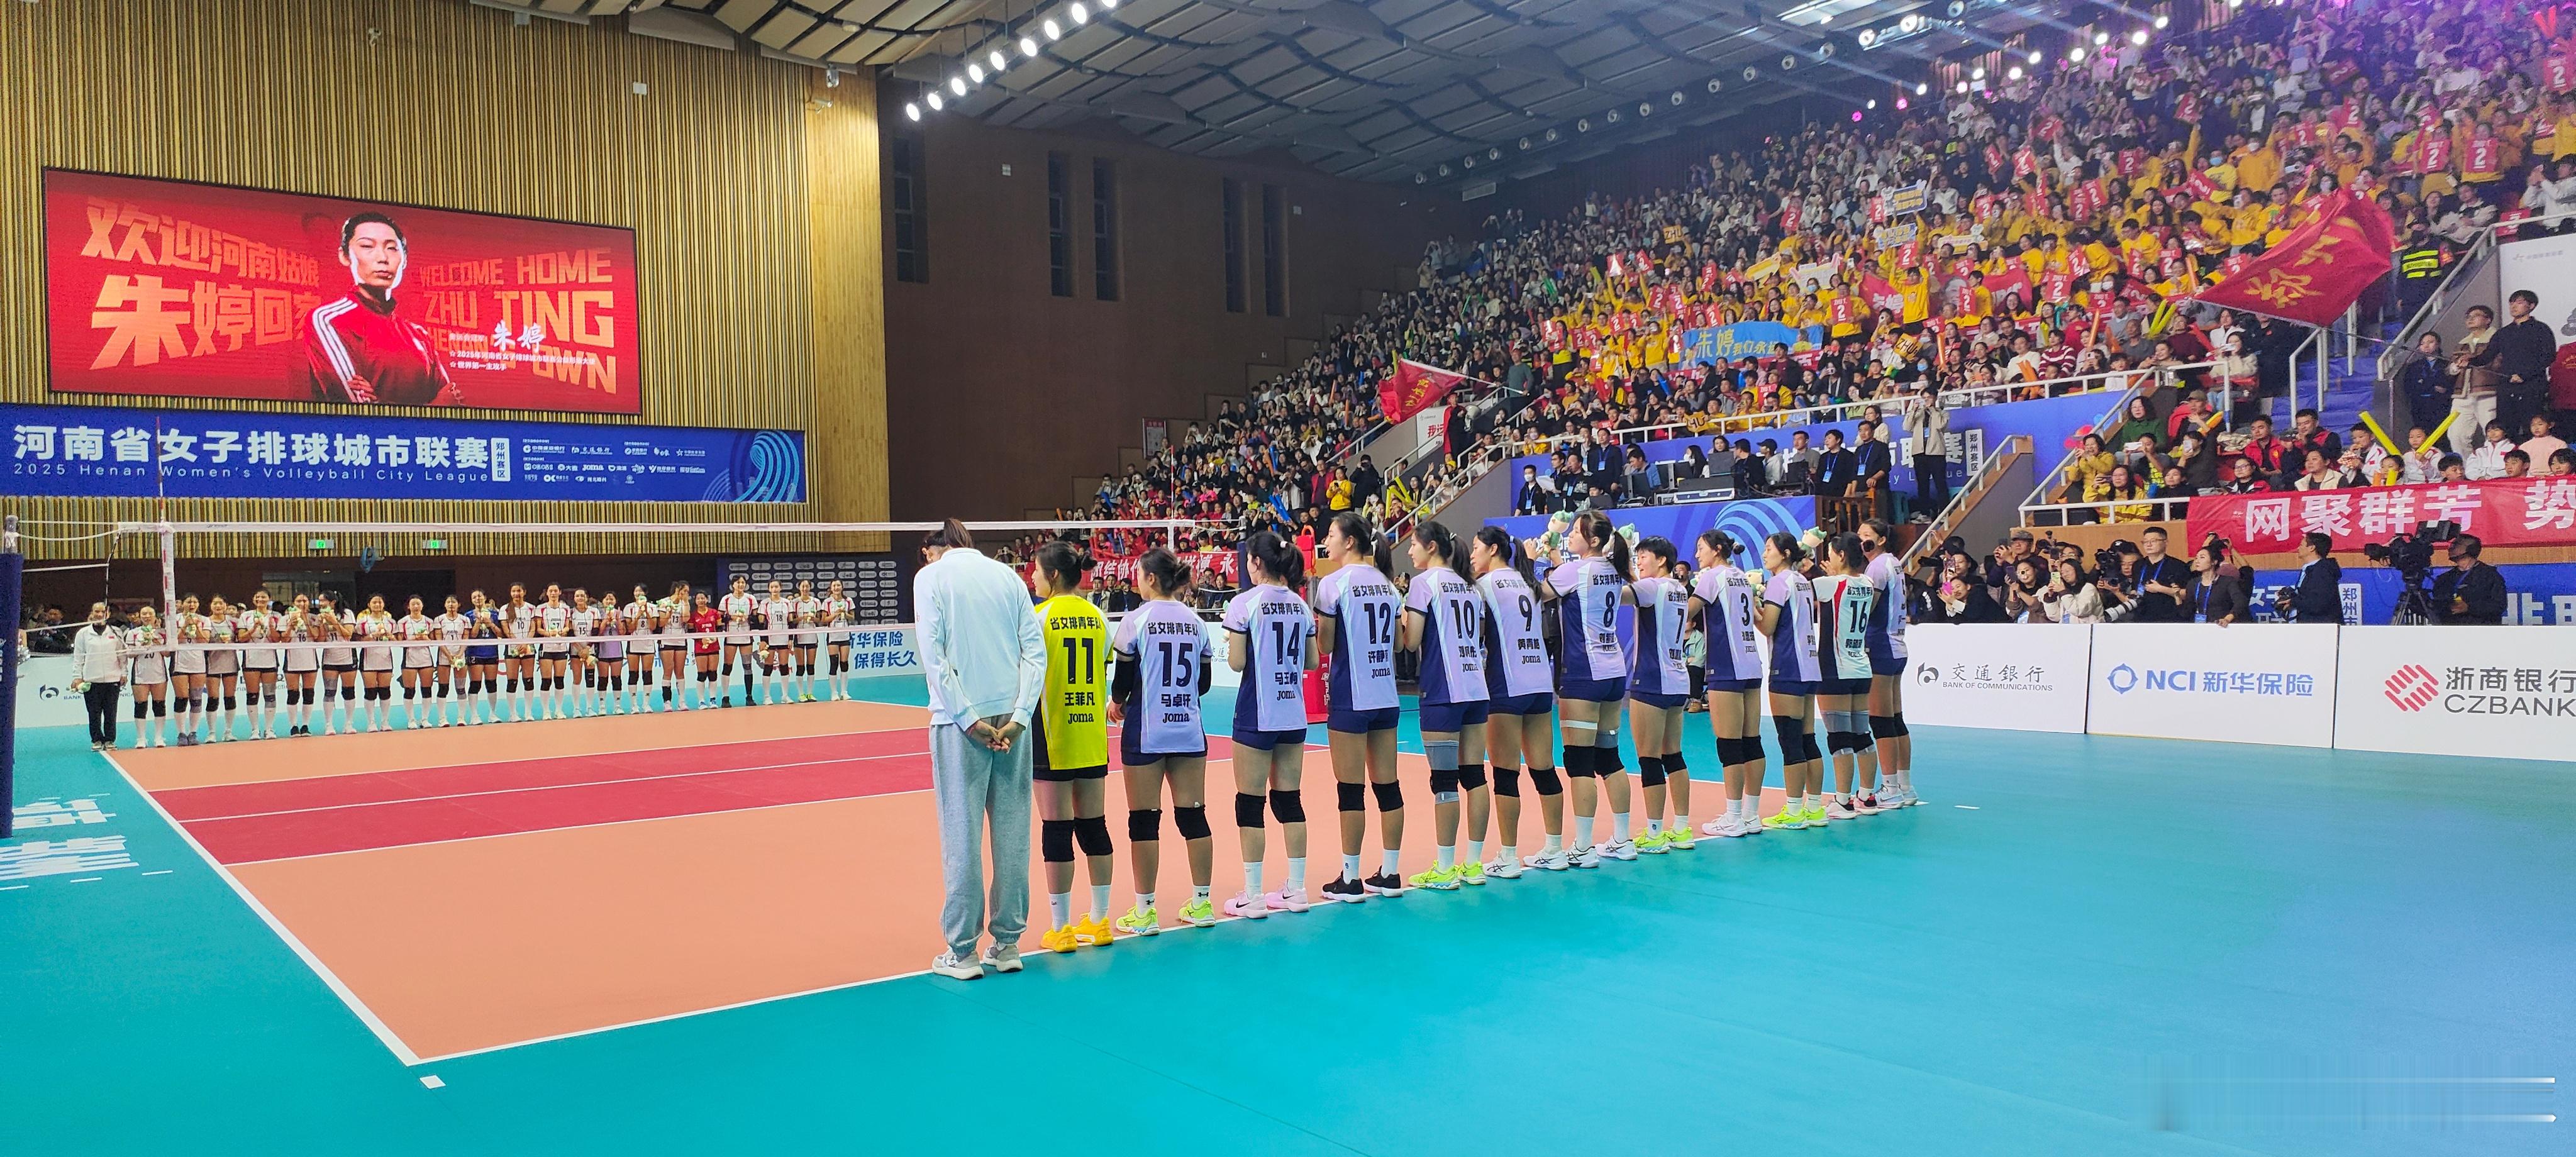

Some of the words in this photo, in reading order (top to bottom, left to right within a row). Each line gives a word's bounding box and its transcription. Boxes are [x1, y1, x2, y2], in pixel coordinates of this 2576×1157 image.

[2428, 148, 2439, 165] 2
[2474, 148, 2487, 165] 2
[80, 196, 319, 287] 欢迎河南姑娘
[1665, 226, 1682, 241] ZHU
[419, 258, 504, 287] WELCOME
[516, 248, 613, 285] HOME
[1902, 249, 1911, 262] 2
[2052, 281, 2063, 296] 2
[424, 291, 478, 329] ZHU
[494, 291, 614, 348] TING
[1837, 305, 1845, 319] 2
[493, 319, 545, 352] 朱婷
[1697, 329, 1735, 358] 朱婷
[533, 344, 617, 394] OWN
[14, 424, 488, 468] 河南省女子排球城市联赛
[496, 442, 505, 478] 郑州赛区
[1969, 433, 1979, 472] 郑州赛区
[14, 463, 65, 475] 2025
[80, 465, 146, 476] Henan
[159, 466, 251, 478] Women's
[264, 467, 365, 482] Volleyball
[376, 470, 413, 482] City
[425, 470, 488, 484] League
[2245, 485, 2482, 543] 网聚群芳
[2524, 480, 2576, 529] 势
[776, 614, 783, 622] 18
[1050, 616, 1102, 630] 省女排青年队
[1363, 602, 1391, 645] 12
[1450, 599, 1475, 639] 10
[1518, 595, 1533, 632] 9
[1603, 590, 1615, 628] 8
[1675, 607, 1684, 644] 7
[1740, 592, 1751, 626] 3
[1806, 597, 1813, 630] 1
[1850, 600, 1868, 633] 16
[579, 627, 586, 635] 15
[1272, 621, 1300, 665] 14
[854, 650, 917, 670] 保得长久
[1063, 637, 1094, 685] 11
[1159, 642, 1193, 687] 15
[1951, 663, 2045, 684] 交通銀行
[1977, 682, 2053, 692] COMMUNICATIONS
[2146, 670, 2196, 691] NCI
[2202, 671, 2314, 697] 新华保险
[2445, 667, 2576, 694] 浙商银行
[1065, 692, 1095, 706] 王菲凡
[2444, 694, 2576, 717] CZBANK
